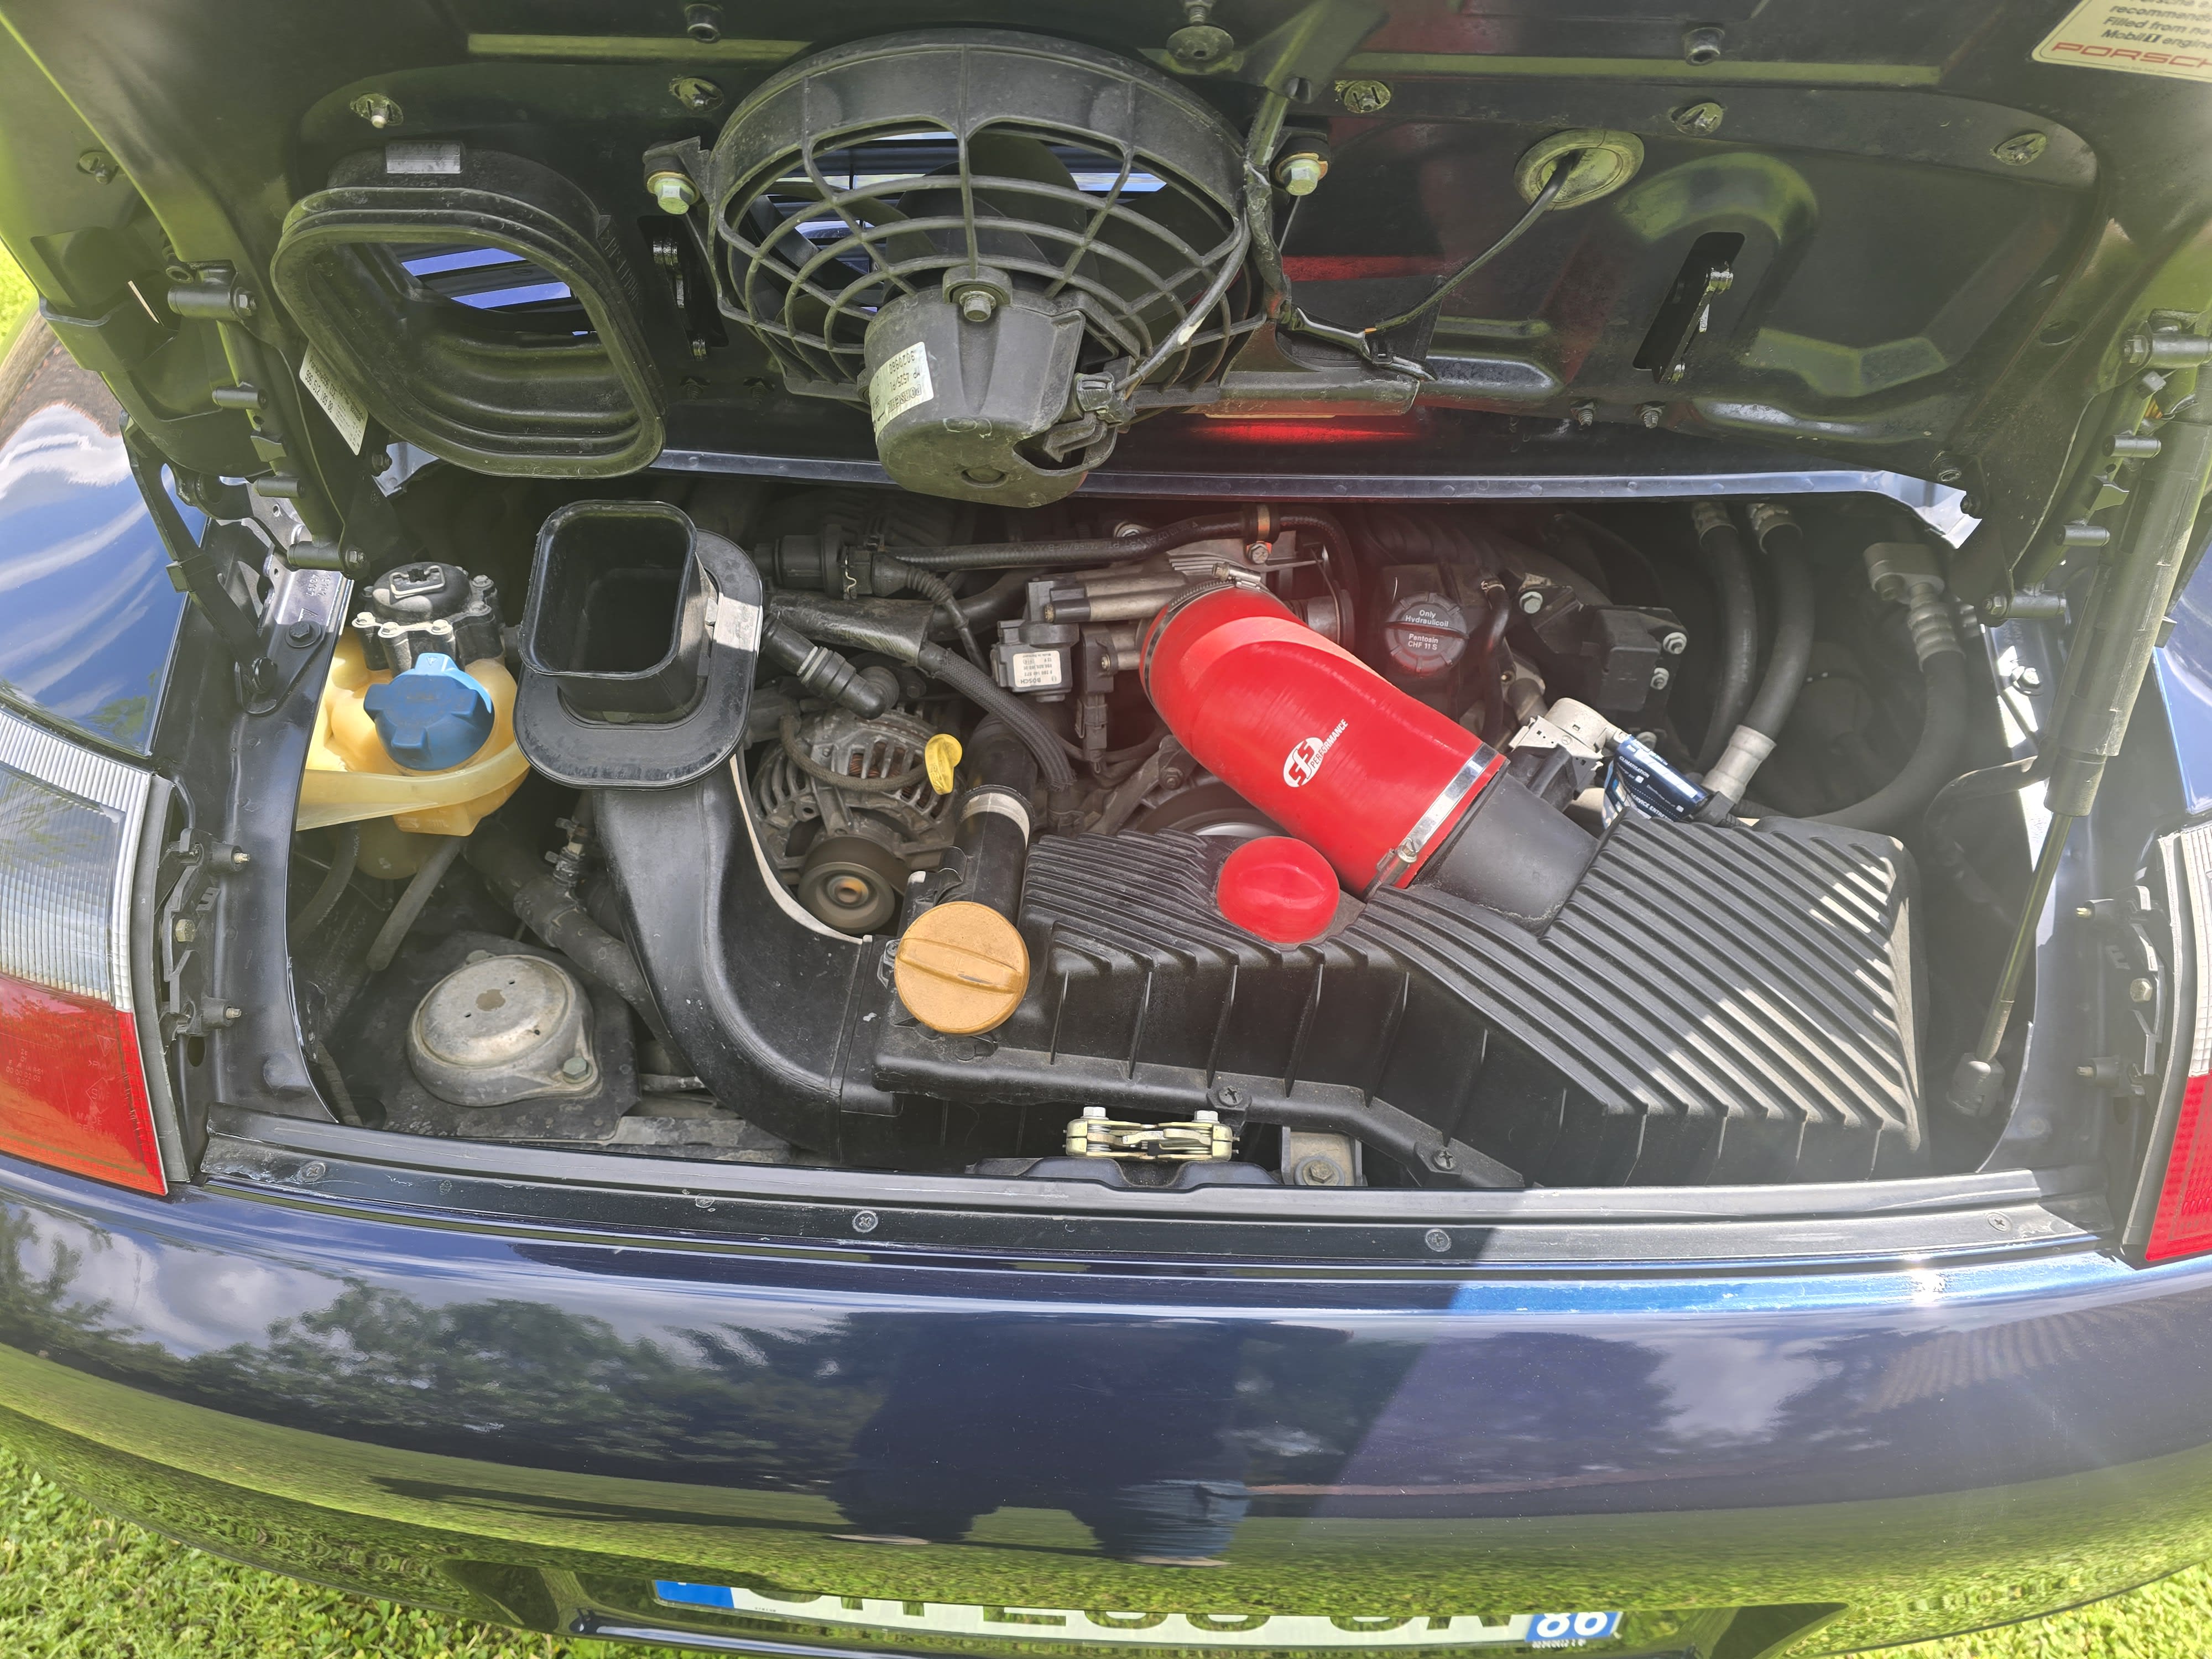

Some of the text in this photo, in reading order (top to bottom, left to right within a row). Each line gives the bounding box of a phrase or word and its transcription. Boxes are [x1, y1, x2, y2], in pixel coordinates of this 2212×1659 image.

[1405, 615, 1449, 627] Hydraulicoil
[1419, 609, 1436, 619] Only
[1408, 633, 1438, 644] Pentosin
[1310, 718, 1349, 769] PERFORMANCE
[1619, 756, 1650, 778] CLIMATISATION
[76, 1123, 118, 1140] GERMAN
